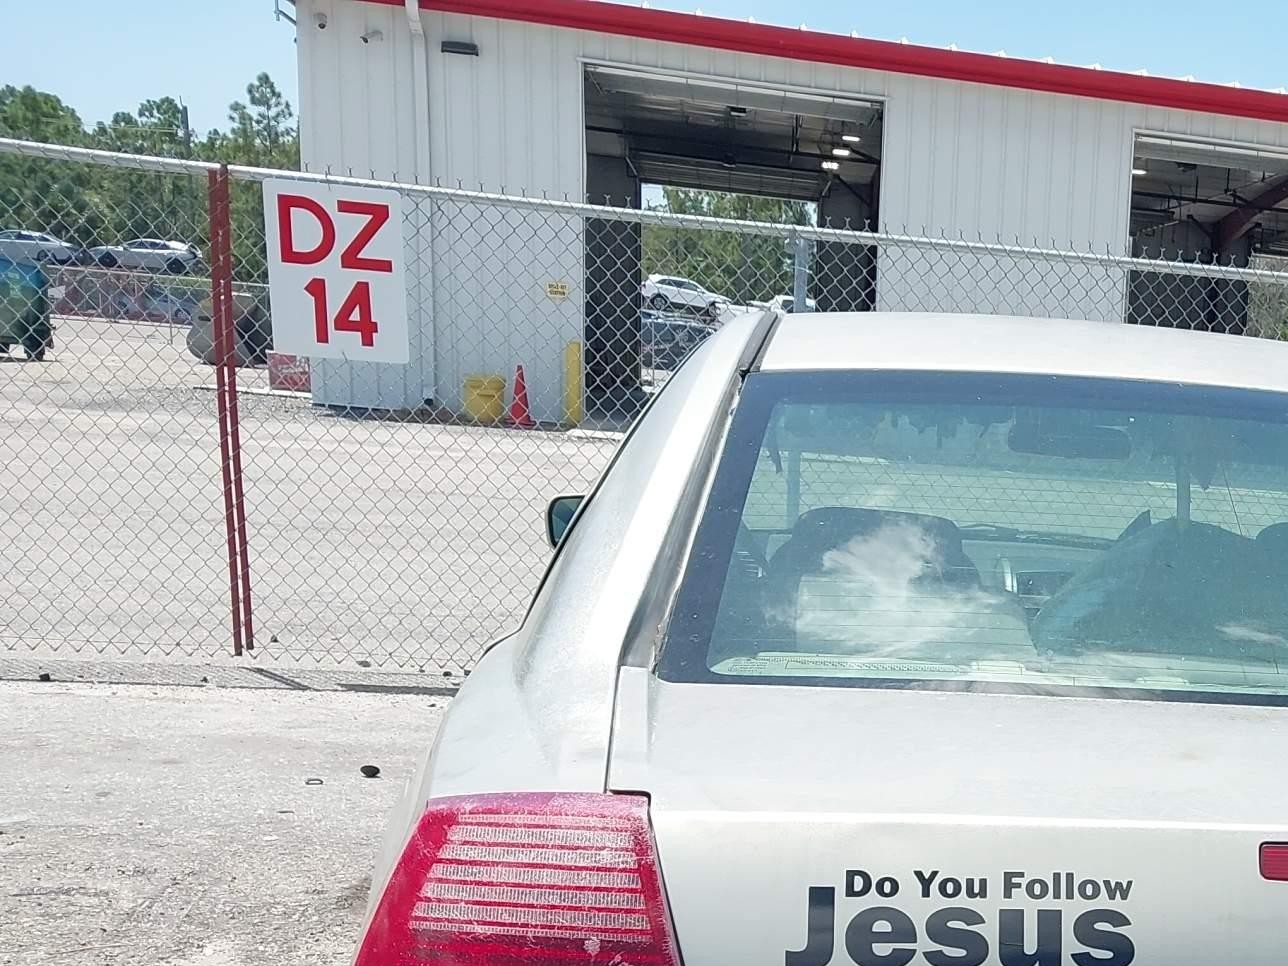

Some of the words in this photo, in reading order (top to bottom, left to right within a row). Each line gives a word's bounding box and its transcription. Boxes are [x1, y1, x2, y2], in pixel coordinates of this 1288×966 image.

[276, 193, 393, 273] DZ
[304, 277, 378, 347] 14
[845, 869, 900, 899] Do
[913, 870, 988, 900] You
[1003, 871, 1134, 901] Follow
